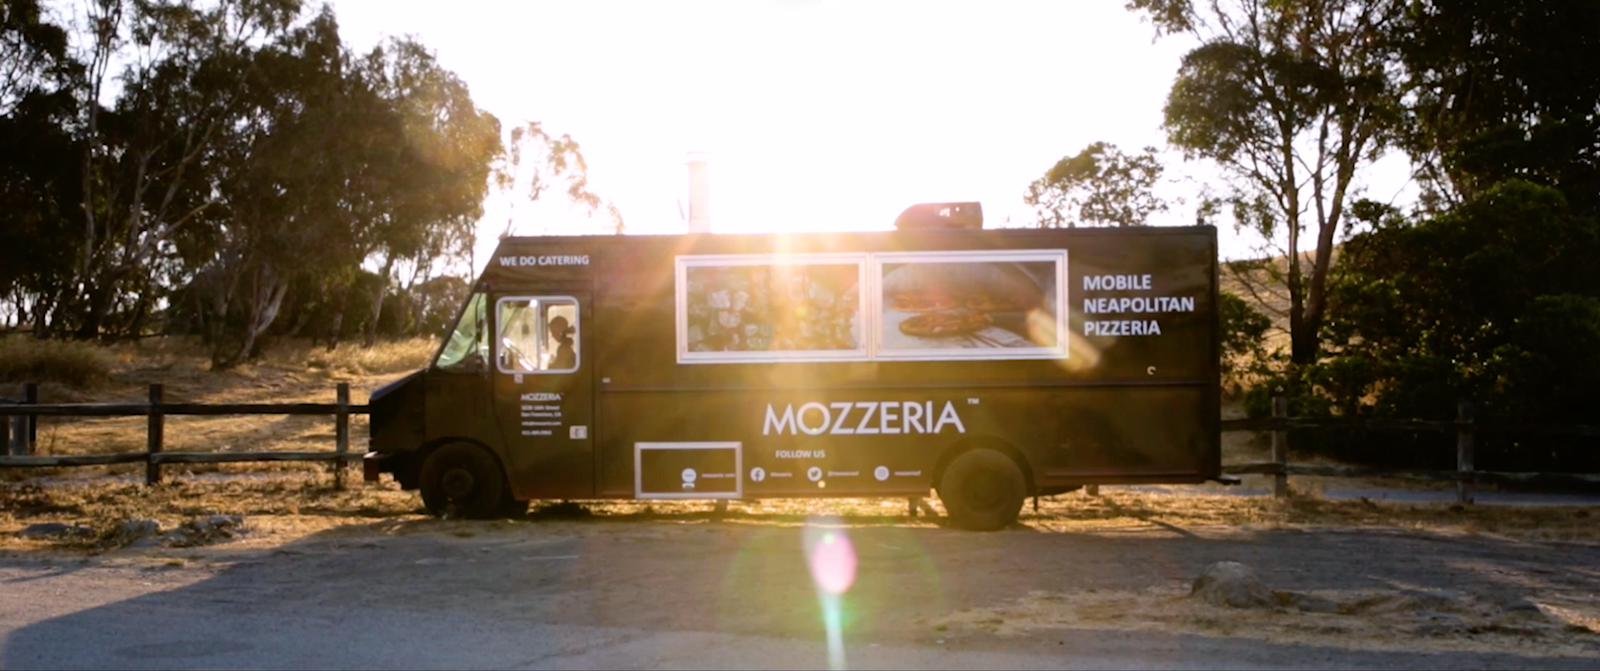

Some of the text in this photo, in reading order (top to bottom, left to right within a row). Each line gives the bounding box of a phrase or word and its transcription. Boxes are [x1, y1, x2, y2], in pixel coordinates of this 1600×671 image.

[500, 255, 590, 266] WE DO CATERING
[1083, 274, 1152, 290] MOBILE
[1083, 297, 1195, 313] NEAPOLITAN
[1084, 320, 1162, 336] PIZZERIA
[762, 400, 966, 436] MOZZERIA
[775, 450, 826, 459] FOLLOW US
